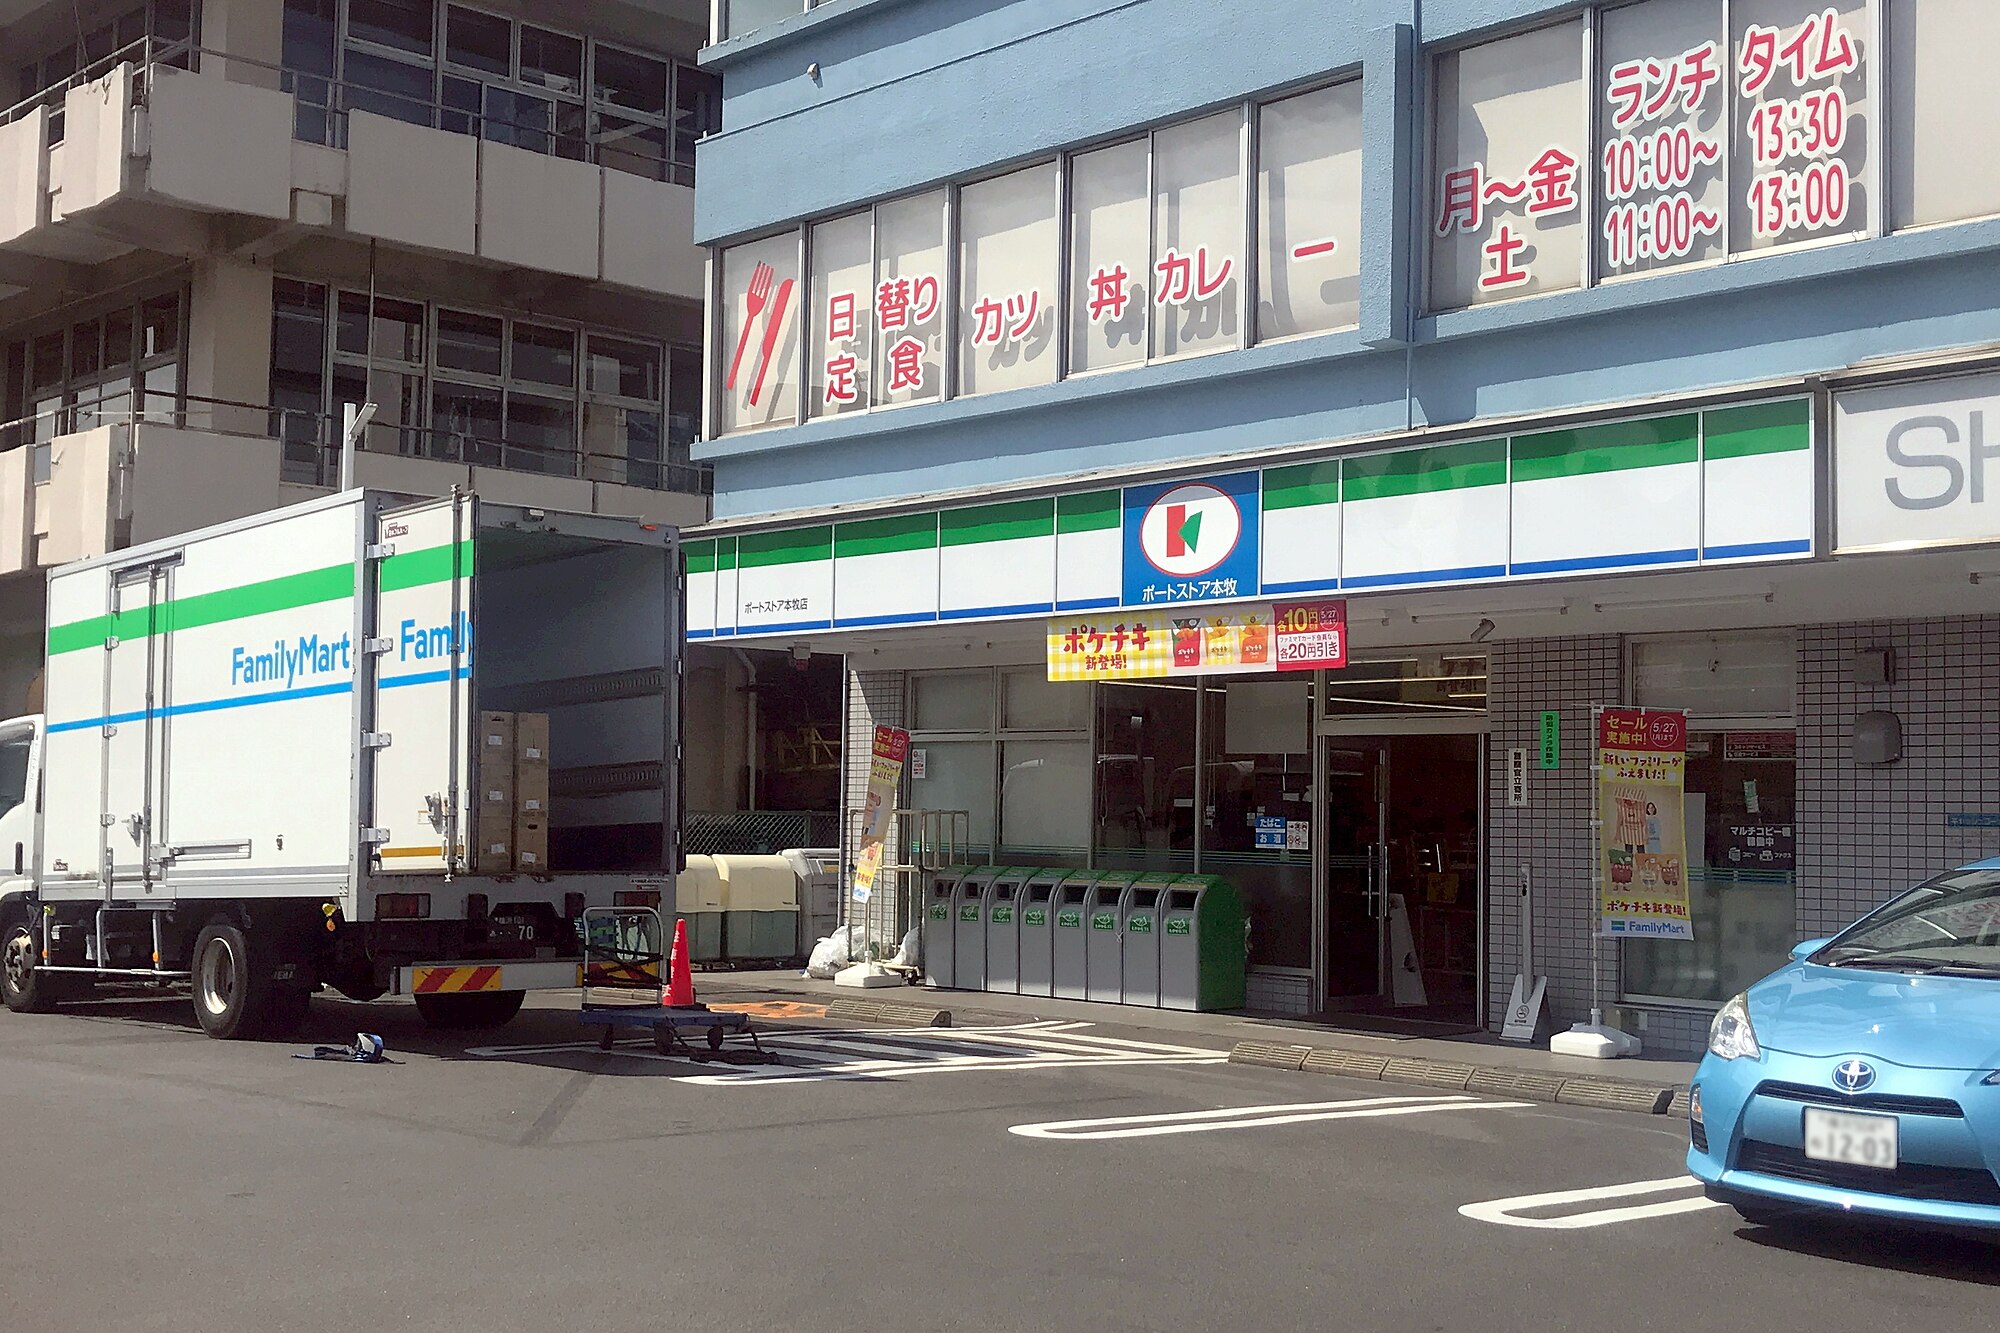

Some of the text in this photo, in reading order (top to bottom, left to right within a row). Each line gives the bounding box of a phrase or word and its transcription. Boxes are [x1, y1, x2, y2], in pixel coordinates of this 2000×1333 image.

[1611, 12, 1855, 125] ランチ タイム
[1751, 91, 1844, 162] 13:30
[1481, 226, 1528, 287] 土
[1751, 162, 1845, 234] 13:00
[1142, 577, 1238, 602] ポートストア本牧
[744, 597, 808, 614] ポートストア本牧店
[1063, 622, 1151, 654] ポケチキ
[231, 632, 350, 689] FamilyMart
[1607, 715, 1648, 730] セール
[1606, 731, 1647, 746] 実施中!
[1259, 818, 1281, 828] たばこ
[1628, 920, 1685, 934] FamilyMart
